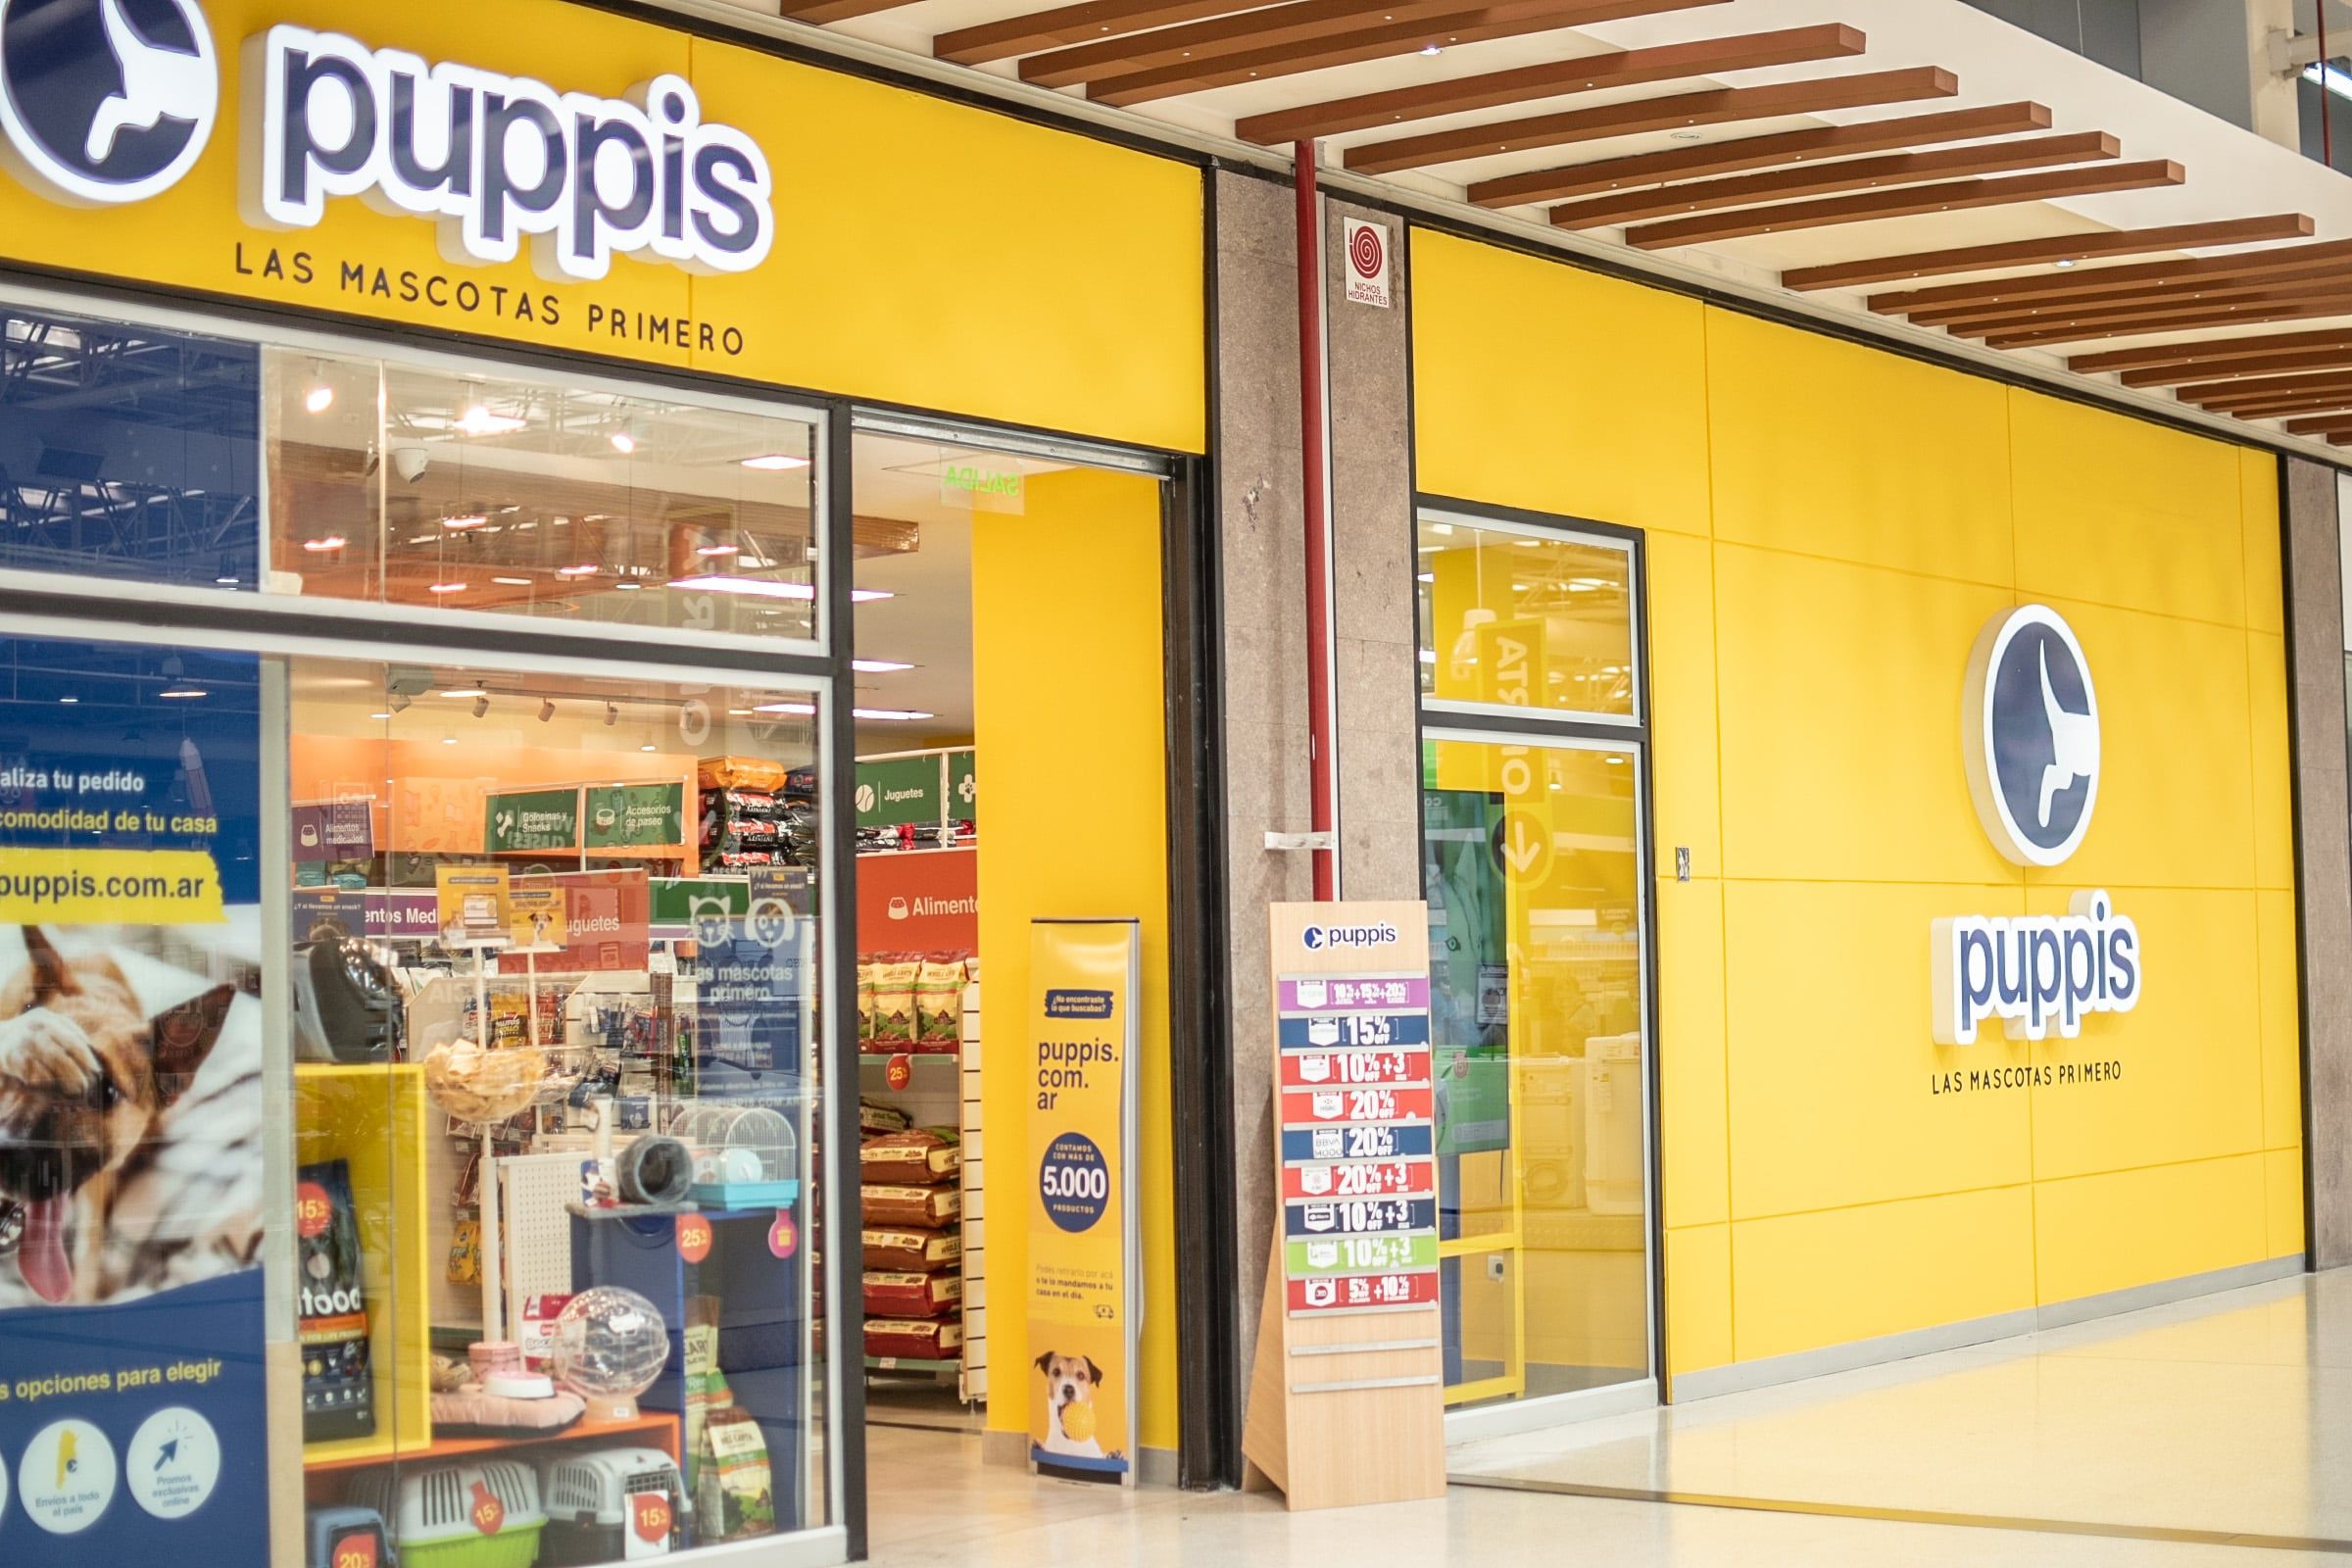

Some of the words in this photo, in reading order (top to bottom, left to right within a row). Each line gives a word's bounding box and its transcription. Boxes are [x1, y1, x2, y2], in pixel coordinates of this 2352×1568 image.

[279, 46, 760, 260] puppis
[235, 241, 315, 284] LAS
[340, 261, 562, 326] MASCOTAS
[588, 304, 745, 357] PRIMERO
[1348, 289, 1388, 306] HIDRANTES
[1354, 281, 1381, 295] NICHOS
[53, 769, 74, 790] tu
[78, 771, 145, 795] pedido
[884, 788, 924, 803] Juguetes
[0, 809, 109, 833] omodidad
[115, 811, 140, 833] de
[146, 813, 166, 833] tu
[171, 815, 219, 833] casa
[625, 805, 671, 816] Accesorios
[625, 817, 636, 828] de
[637, 817, 662, 828] paseo
[1329, 923, 1396, 947] puppis
[718, 964, 793, 981] mascotas
[1960, 901, 2135, 1031] puppis
[710, 983, 770, 1005] primero
[1038, 1037, 1119, 1070] puppis.
[1038, 1068, 1090, 1089] com.
[1337, 1053, 1381, 1083] 10%
[1932, 1070, 1963, 1095] LAS
[1970, 1065, 2052, 1091] MASCOTAS
[2059, 1060, 2122, 1085] PRIMERO
[1037, 1091, 1057, 1110] ar
[1349, 1090, 1396, 1120] 20%
[1054, 1143, 1093, 1152] CONTAMOS
[1348, 1127, 1394, 1157] 20%
[1043, 1165, 1106, 1200] 5.000
[1337, 1164, 1382, 1195] 20%
[1053, 1203, 1095, 1214] PRODUCTOS
[1339, 1201, 1384, 1231] 10%
[16, 1371, 112, 1401] opciones
[117, 1368, 162, 1393] para
[166, 1358, 222, 1384] elegir
[152, 1484, 200, 1498] exclusivas
[156, 1473, 192, 1486] Promos
[35, 1495, 68, 1508] Envíos
[70, 1494, 75, 1504] a
[77, 1491, 101, 1502] todo
[162, 1496, 191, 1508] online
